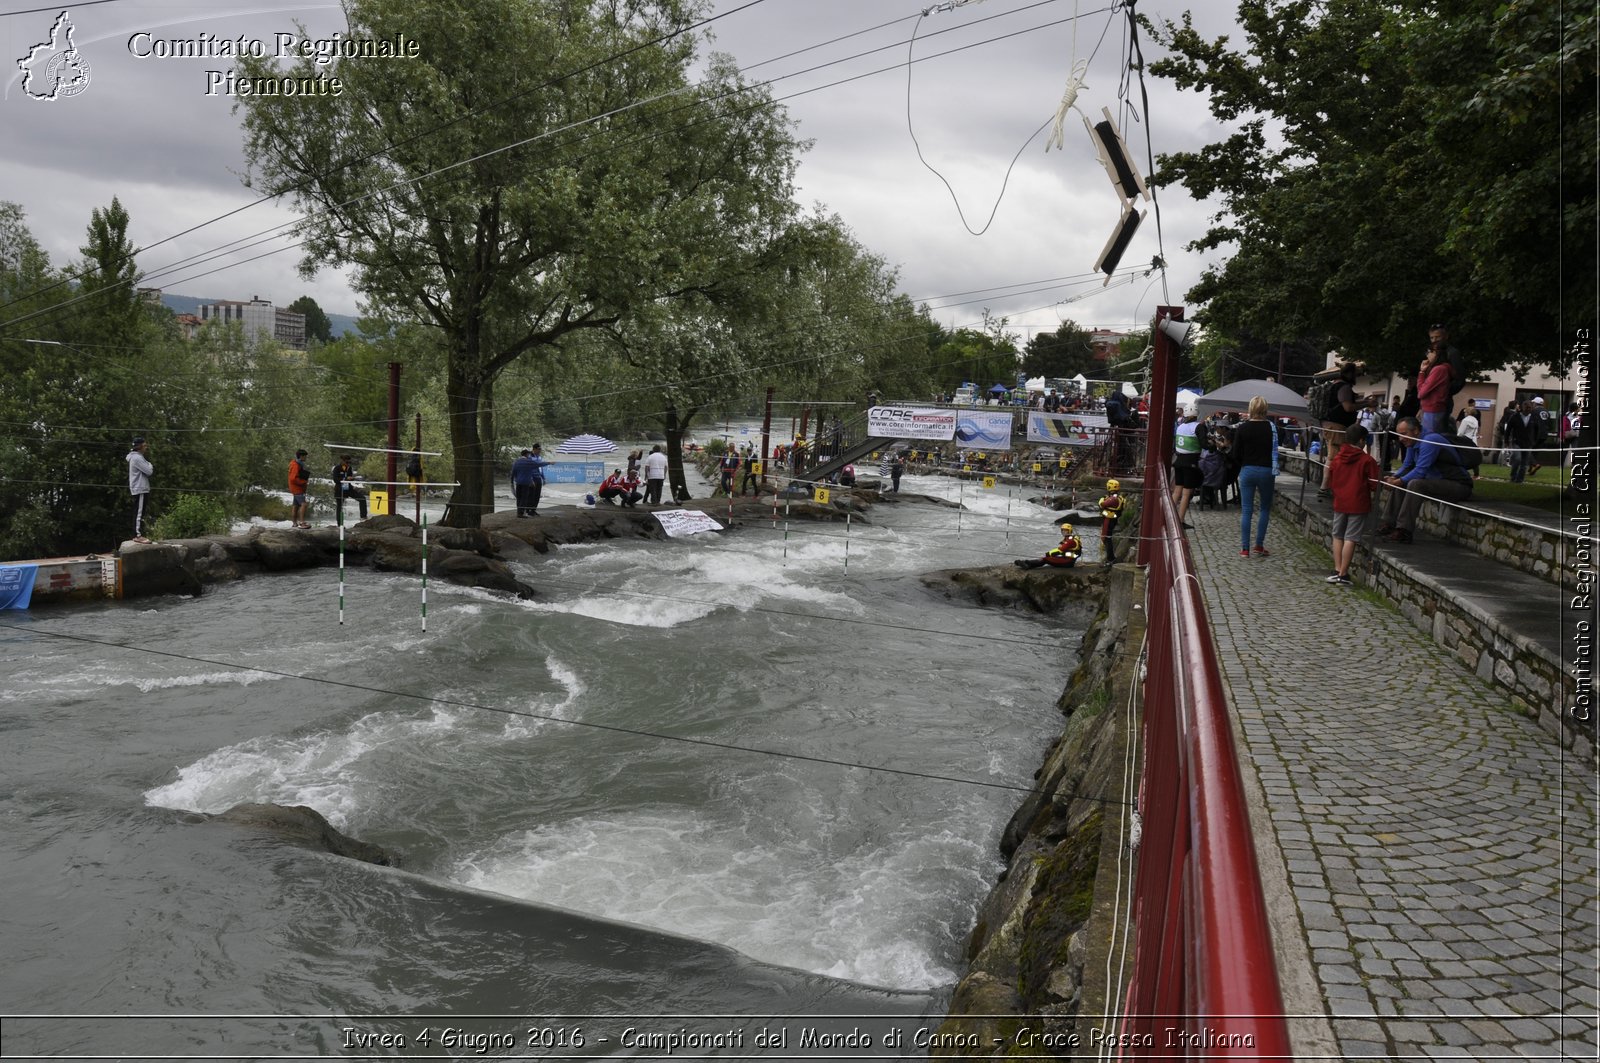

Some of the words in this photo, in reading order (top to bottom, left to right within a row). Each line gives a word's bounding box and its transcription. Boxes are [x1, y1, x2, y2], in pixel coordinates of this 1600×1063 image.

[871, 409, 913, 420] CORE
[870, 421, 954, 430] www.coreinformatica.it
[1178, 436, 1184, 446] 8
[986, 479, 992, 487] 10
[819, 492, 825, 500] 8
[376, 496, 382, 510] 7
